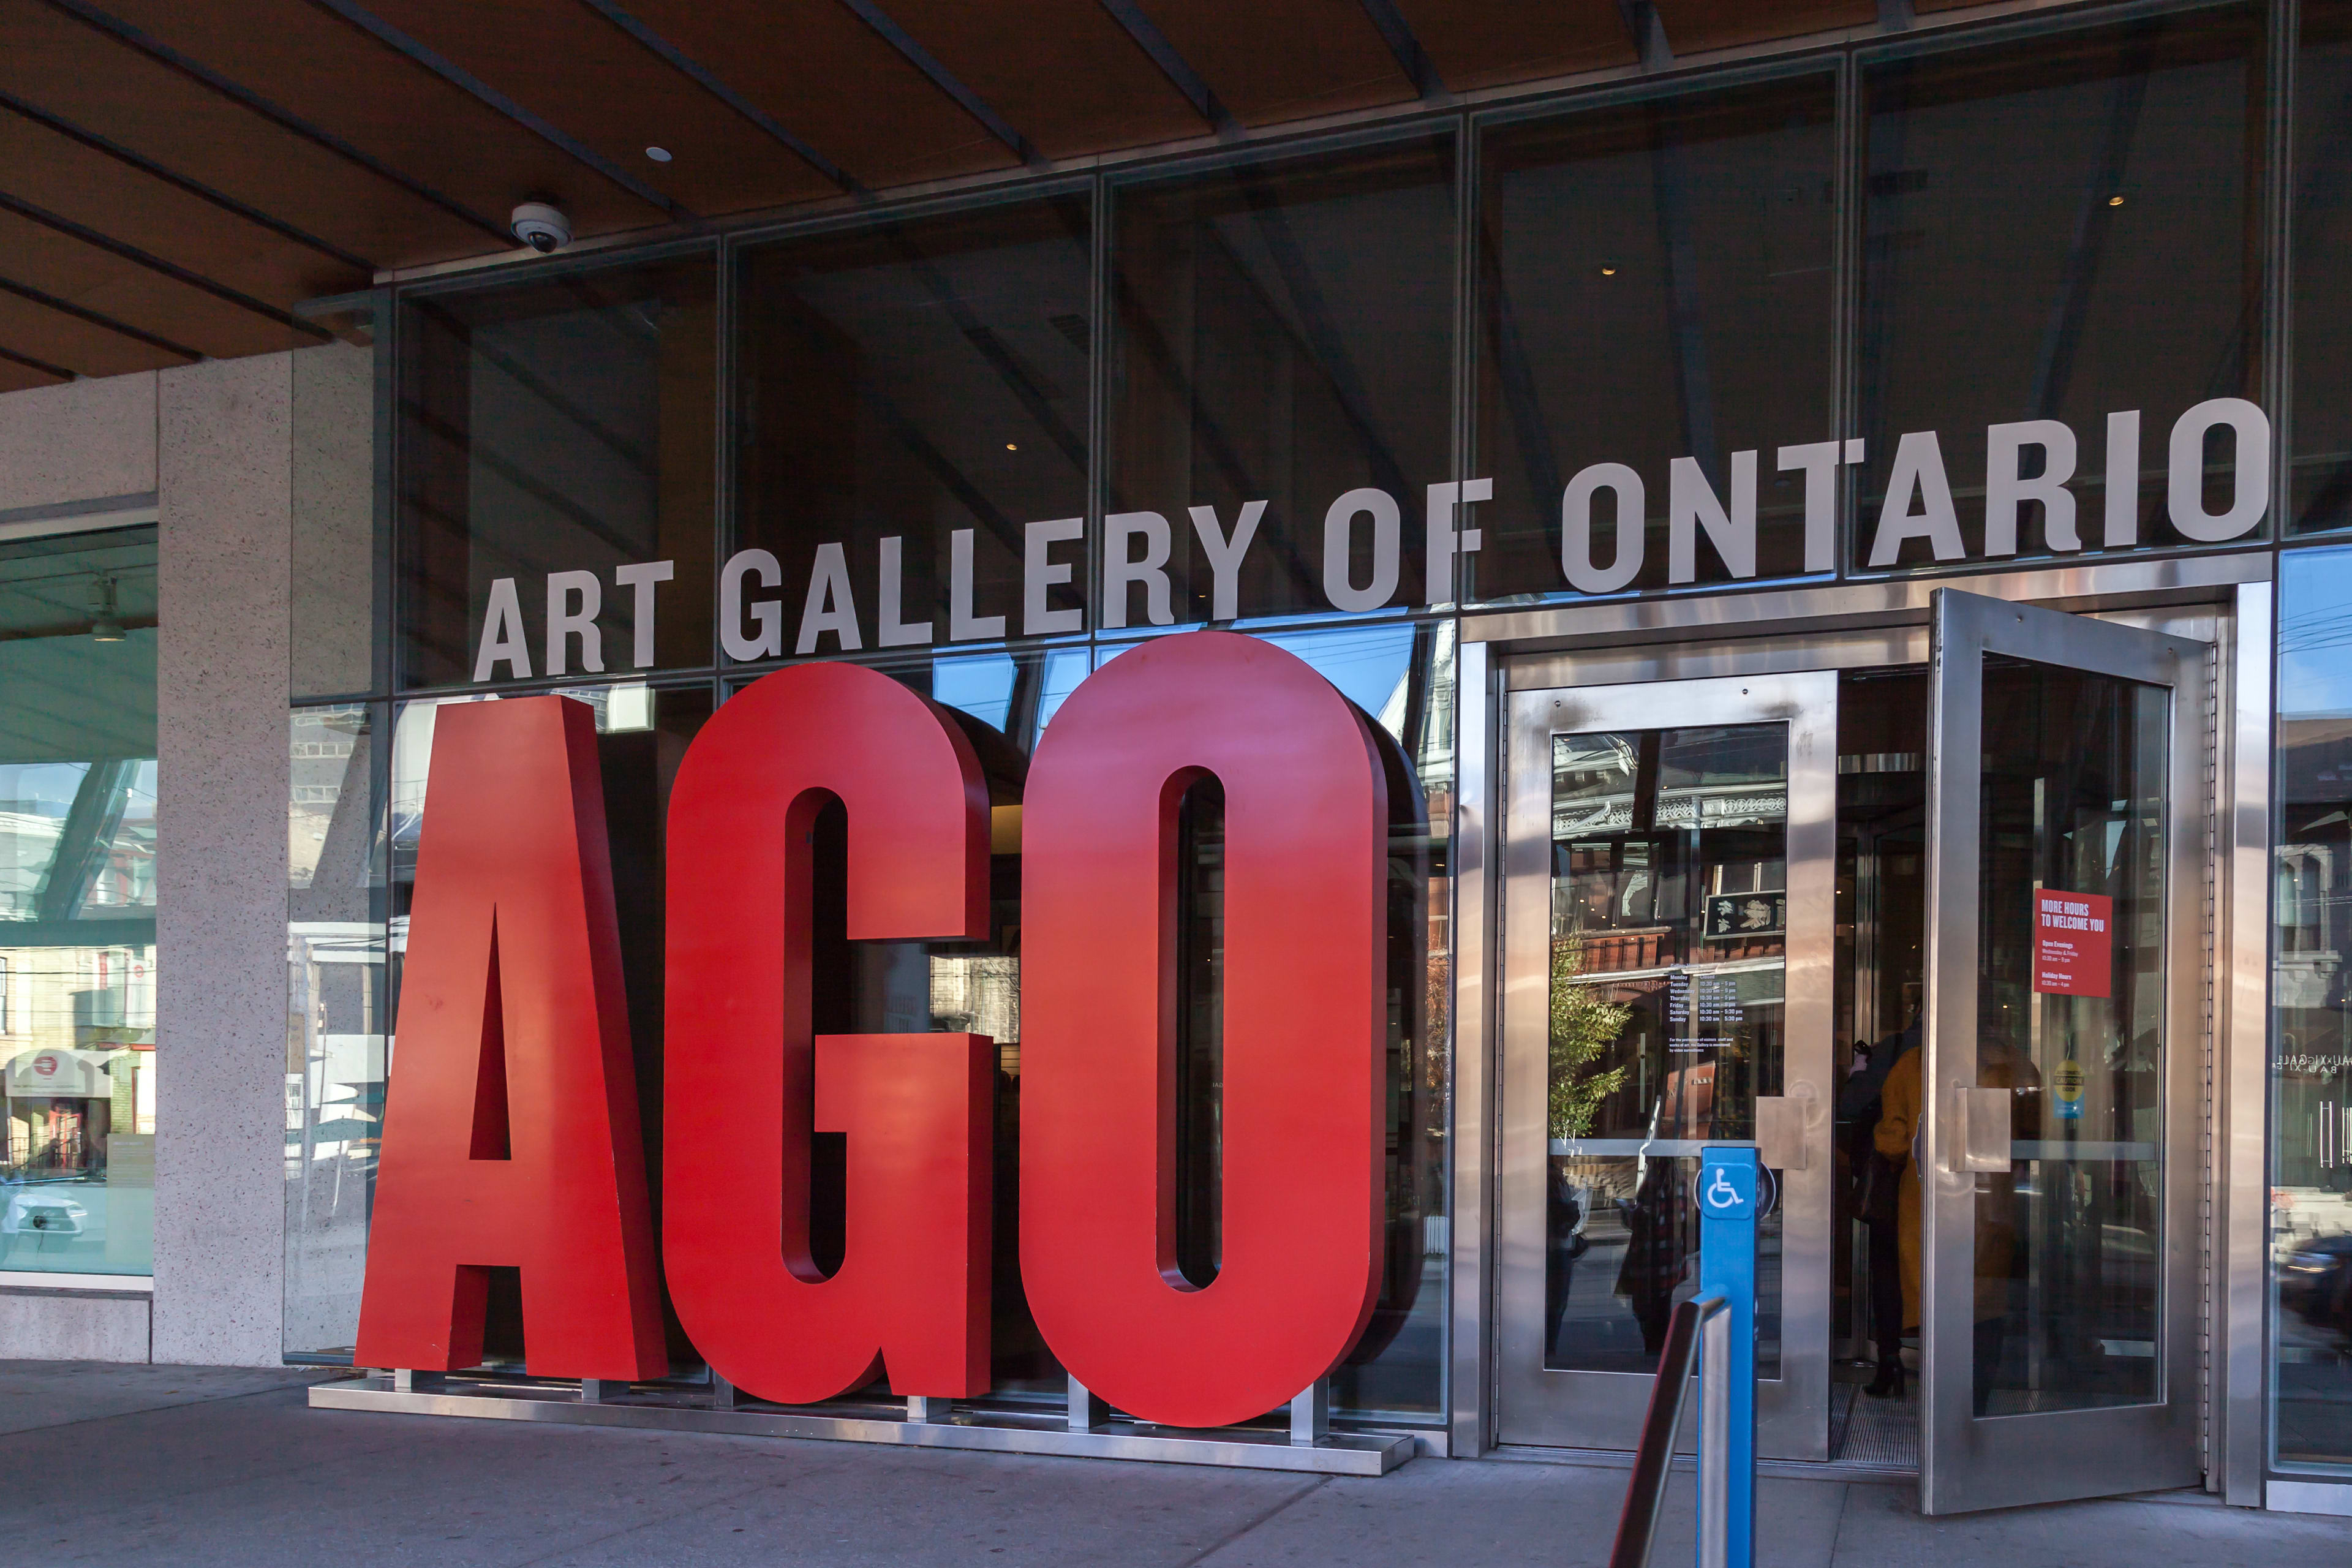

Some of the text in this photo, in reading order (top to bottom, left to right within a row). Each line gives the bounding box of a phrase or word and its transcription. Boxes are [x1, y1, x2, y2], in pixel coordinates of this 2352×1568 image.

[473, 397, 2270, 682] ART GALLERY OF ONTARIO
[2041, 899, 2089, 916] MORE HOURS
[2041, 914, 2104, 932] TO WELCOME YOU
[353, 630, 1388, 1428] AGO
